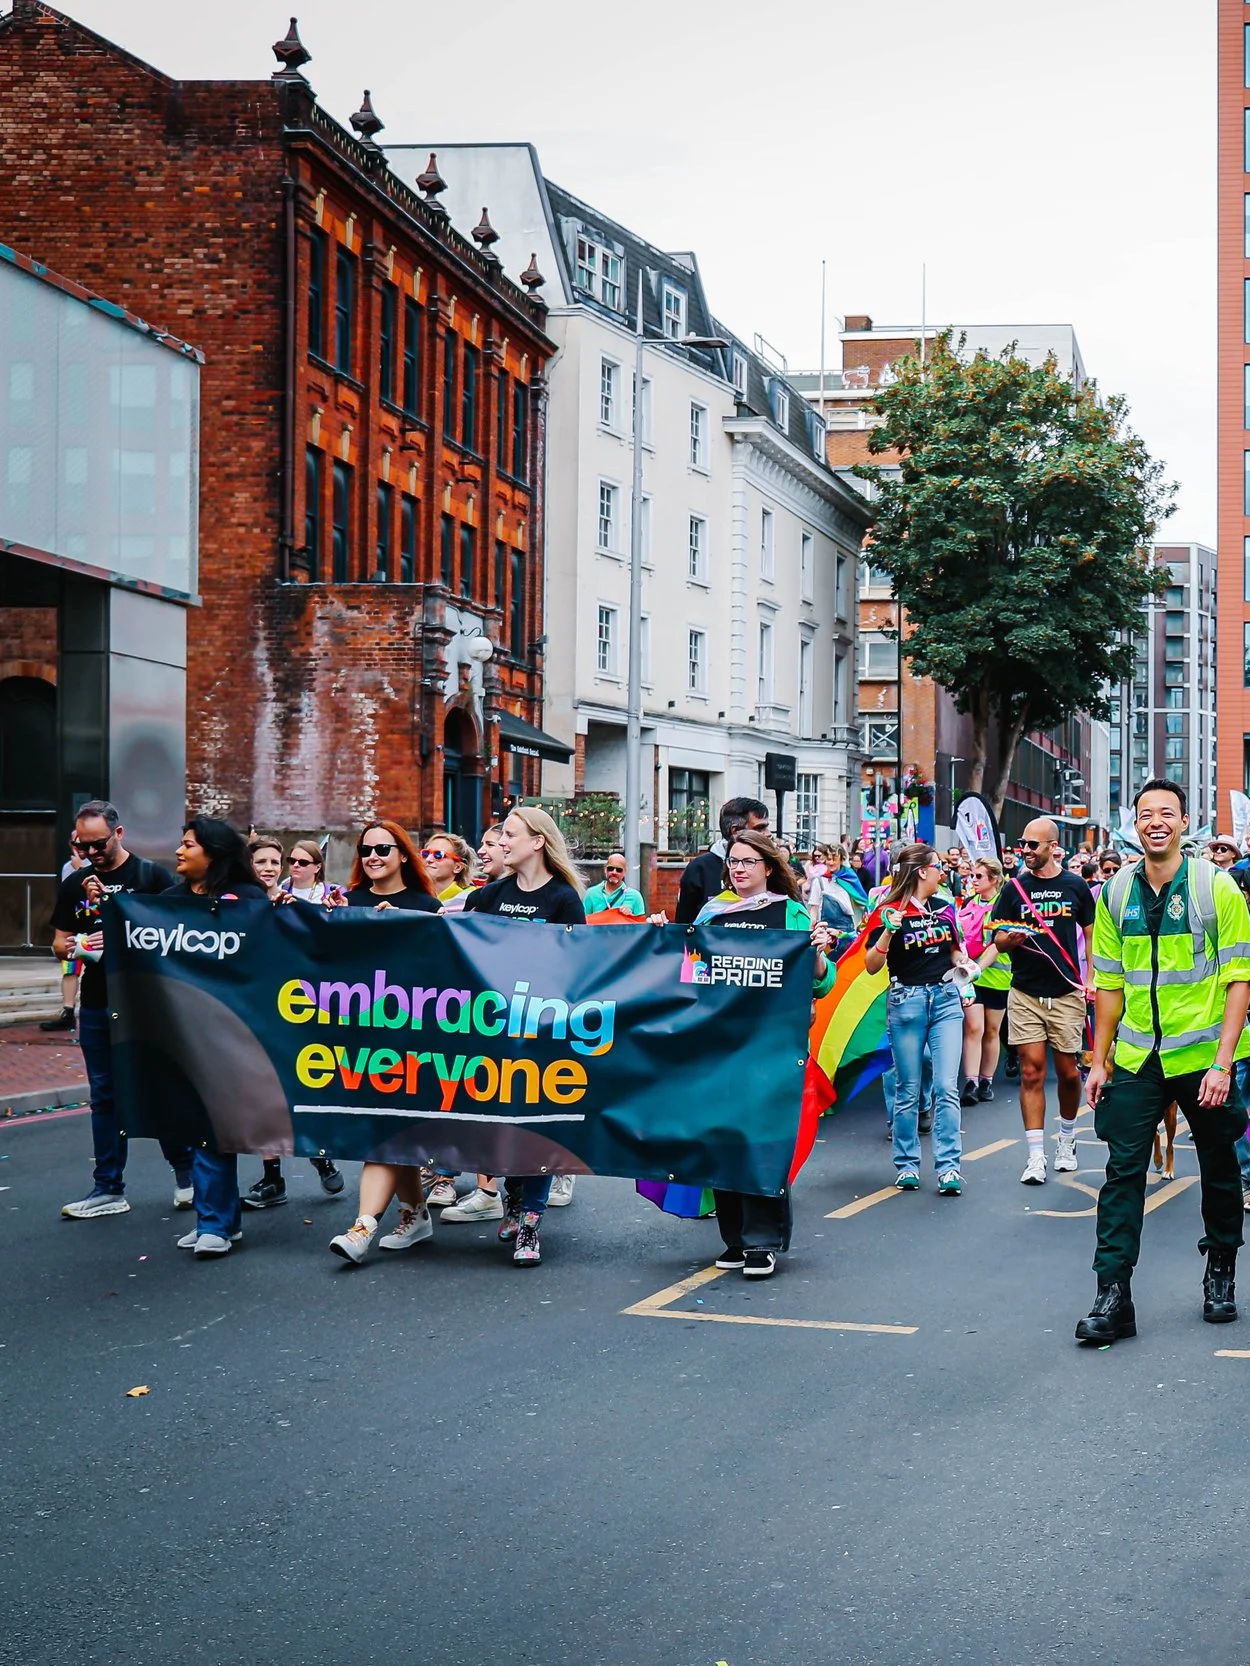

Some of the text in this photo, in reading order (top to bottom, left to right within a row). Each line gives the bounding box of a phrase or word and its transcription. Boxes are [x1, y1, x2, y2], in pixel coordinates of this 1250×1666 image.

[499, 902, 537, 915] keyloop
[1020, 901, 1072, 919] PRIDE
[711, 955, 784, 970] READING
[710, 968, 783, 988] PRIDE
[277, 969, 617, 1056] embracing
[295, 1042, 589, 1112] everyone
